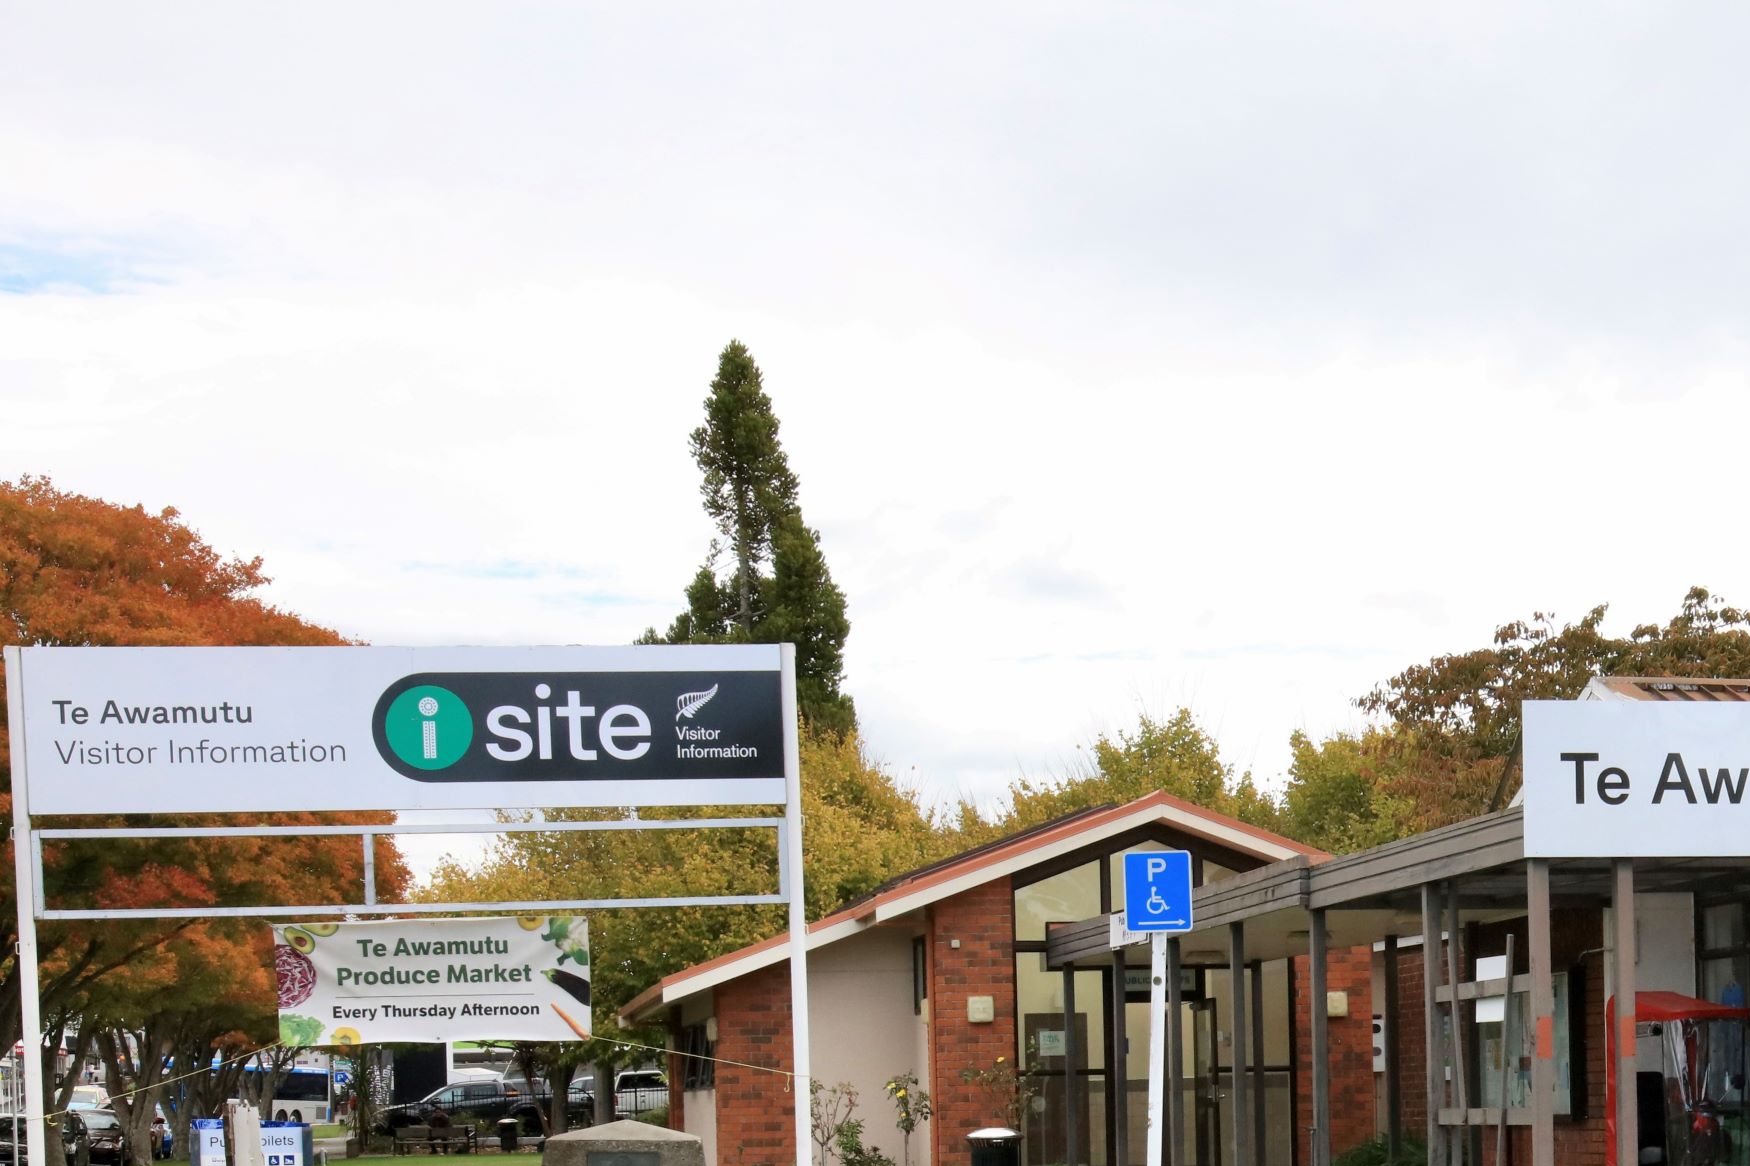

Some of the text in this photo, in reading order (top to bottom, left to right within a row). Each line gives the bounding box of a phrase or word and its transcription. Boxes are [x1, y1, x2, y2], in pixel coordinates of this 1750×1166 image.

[52, 700, 252, 724] Te Awamutu
[485, 683, 652, 761] site
[675, 726, 720, 741] Visitor
[54, 738, 346, 764] Visitor Information
[677, 744, 758, 759] Information
[1560, 752, 1630, 805] Te
[1147, 858, 1167, 882] P
[356, 936, 509, 957] Te Awamutu
[337, 964, 532, 986] Produce Market
[332, 1003, 540, 1021] Every Thursday Afternoon
[261, 1136, 294, 1146] oilets
